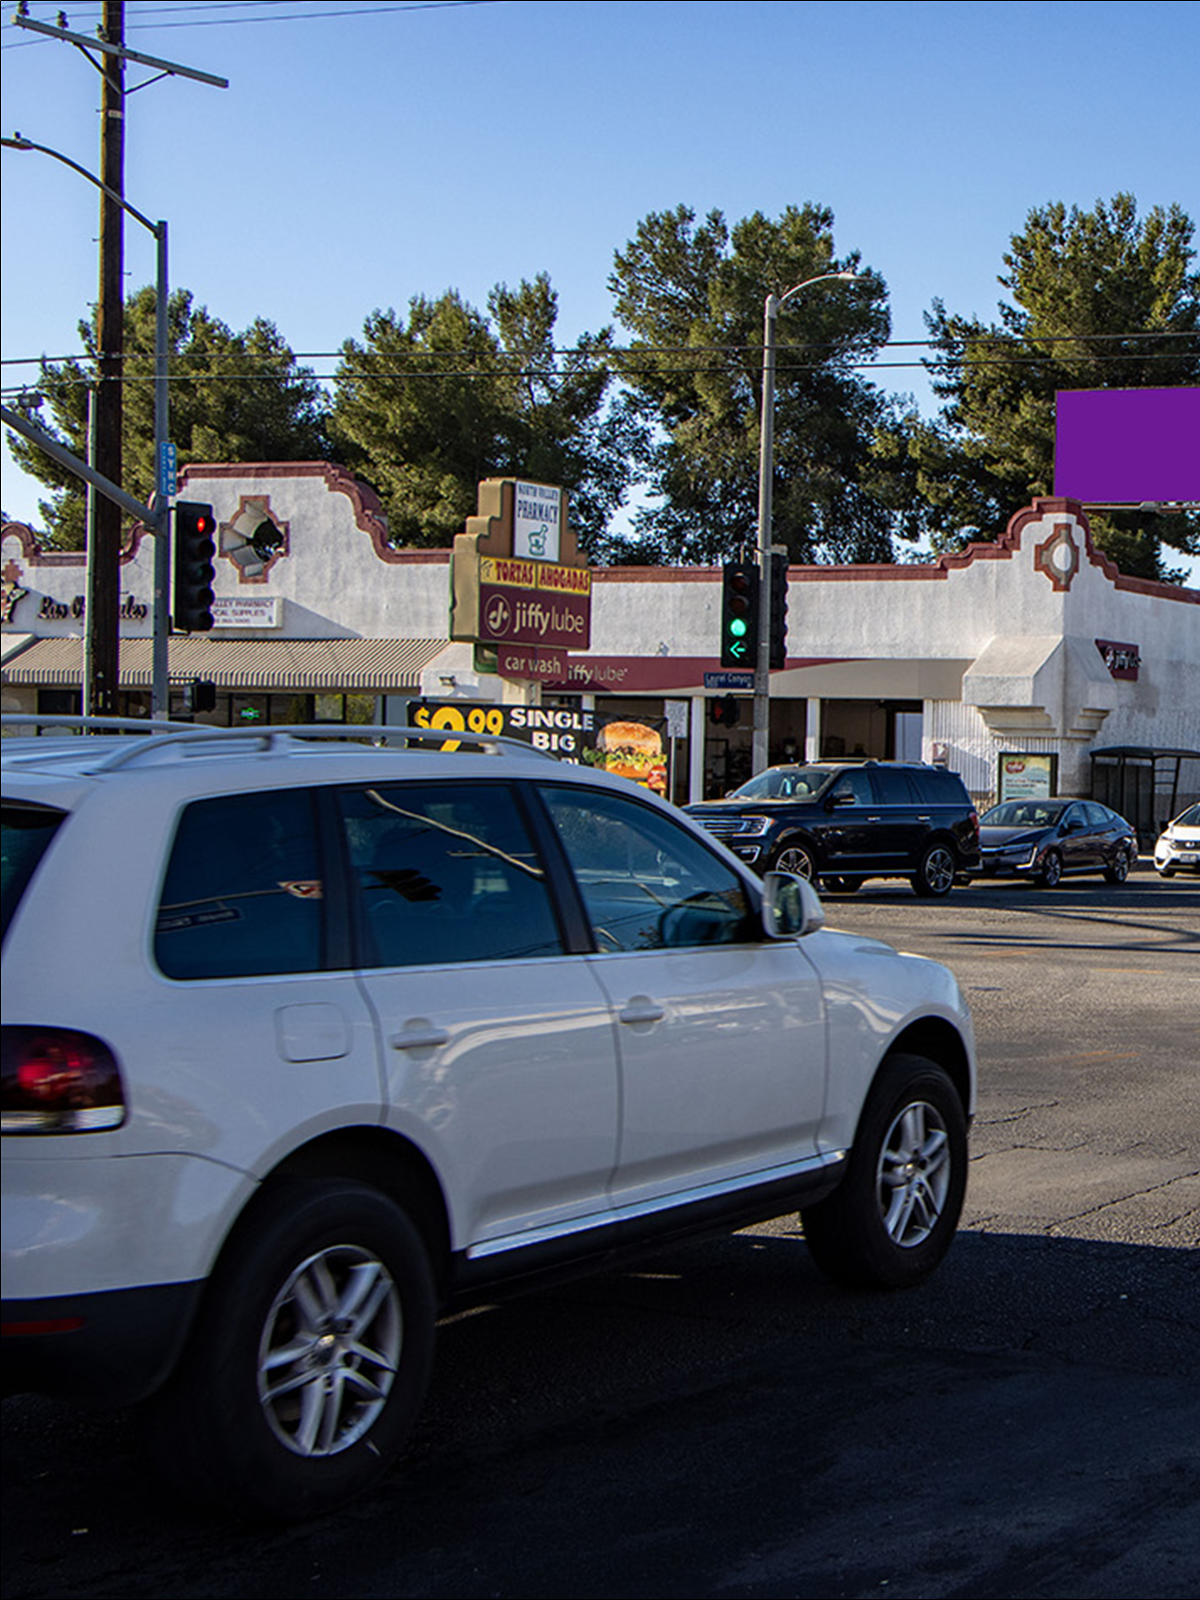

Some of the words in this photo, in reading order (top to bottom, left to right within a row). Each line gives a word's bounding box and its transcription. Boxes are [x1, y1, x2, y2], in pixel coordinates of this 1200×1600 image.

[167, 446, 175, 493] SYNC
[518, 483, 537, 497] NORTH
[518, 499, 558, 524] PHARMACY
[496, 561, 534, 585] TORTAS
[540, 565, 589, 592] AHOGADAS
[505, 656, 525, 671] car
[529, 655, 562, 675] wash
[509, 707, 594, 731] SINGLE
[532, 731, 577, 753] BIG
